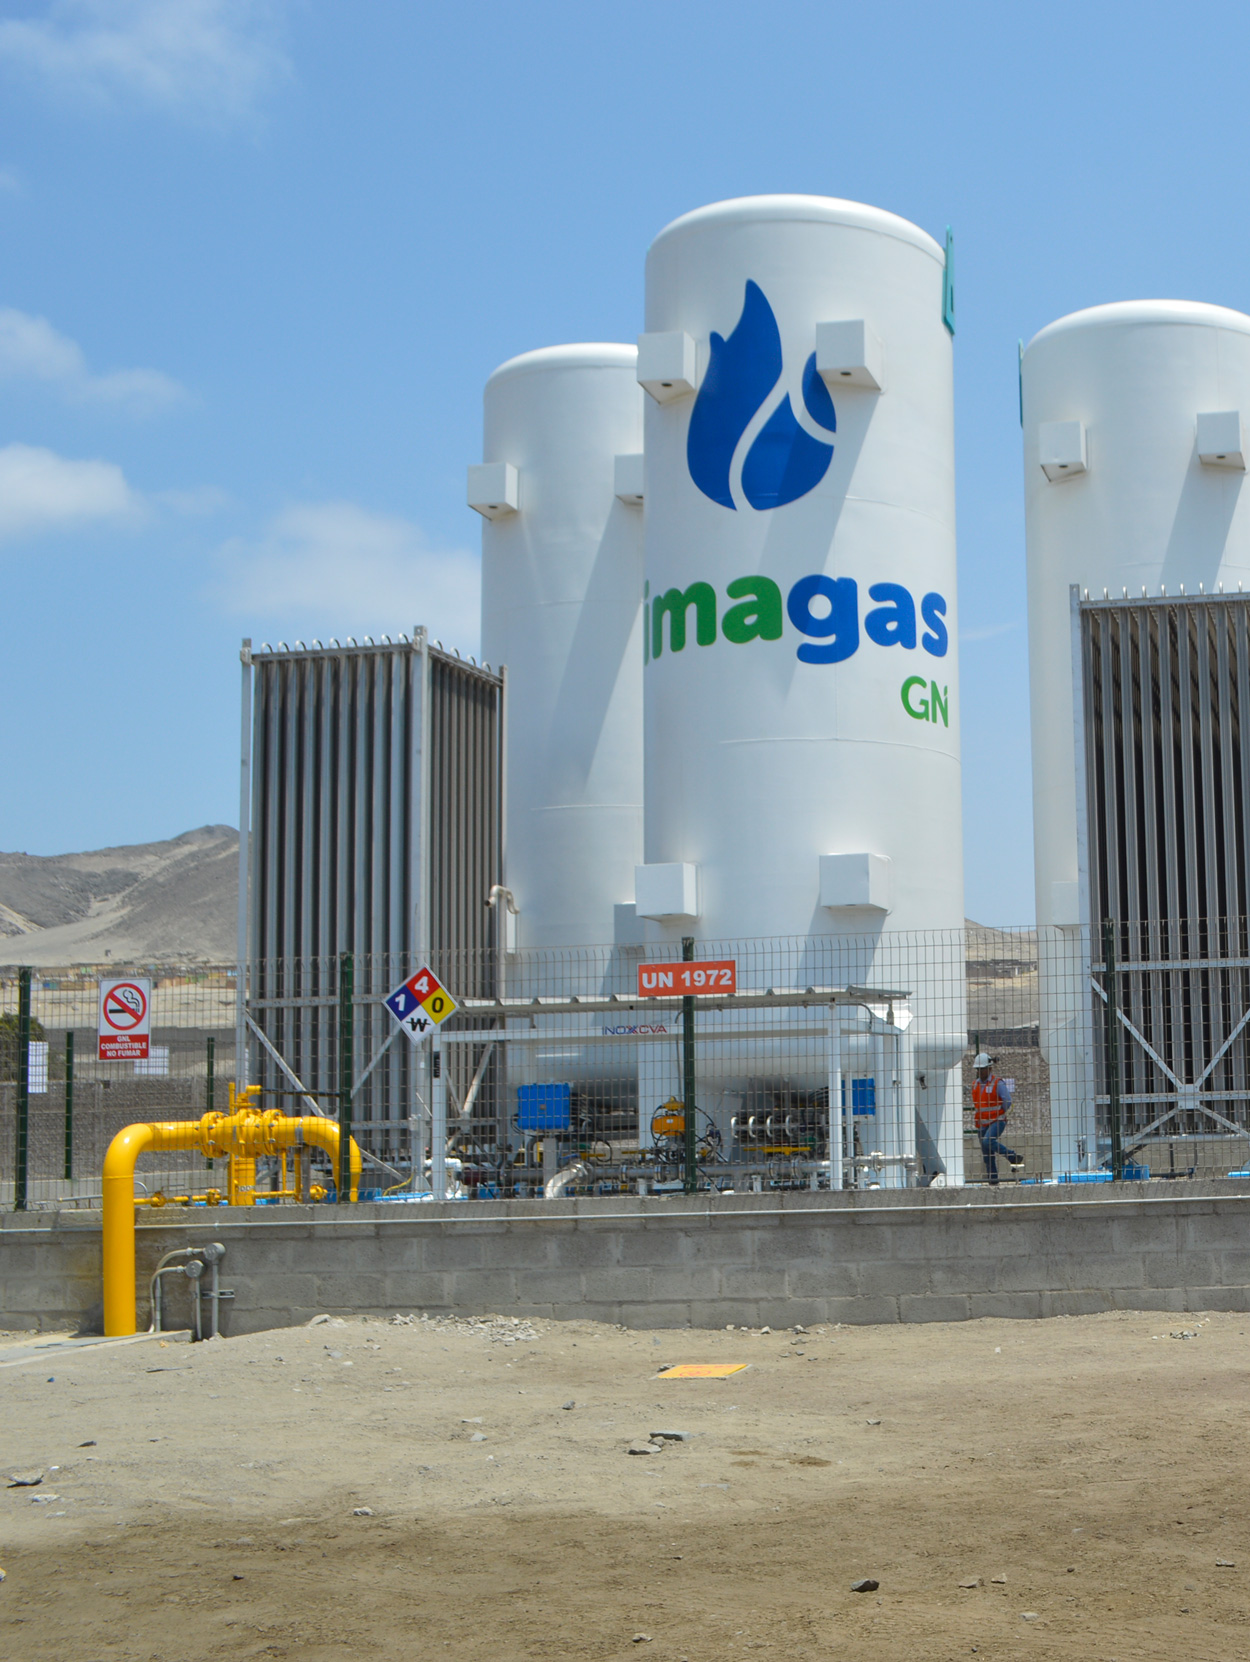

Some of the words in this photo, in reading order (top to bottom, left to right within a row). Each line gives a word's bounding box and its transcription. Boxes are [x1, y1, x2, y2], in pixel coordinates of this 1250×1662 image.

[414, 976, 430, 994] 4
[642, 972, 674, 989] UN
[681, 969, 732, 987] 1972
[395, 994, 406, 1012] 1
[431, 997, 444, 1014] 0
[409, 1017, 428, 1033] W
[101, 1042, 147, 1050] COMBUSTIBLE
[117, 1035, 131, 1043] GNL
[118, 1049, 141, 1057] FUMAR
